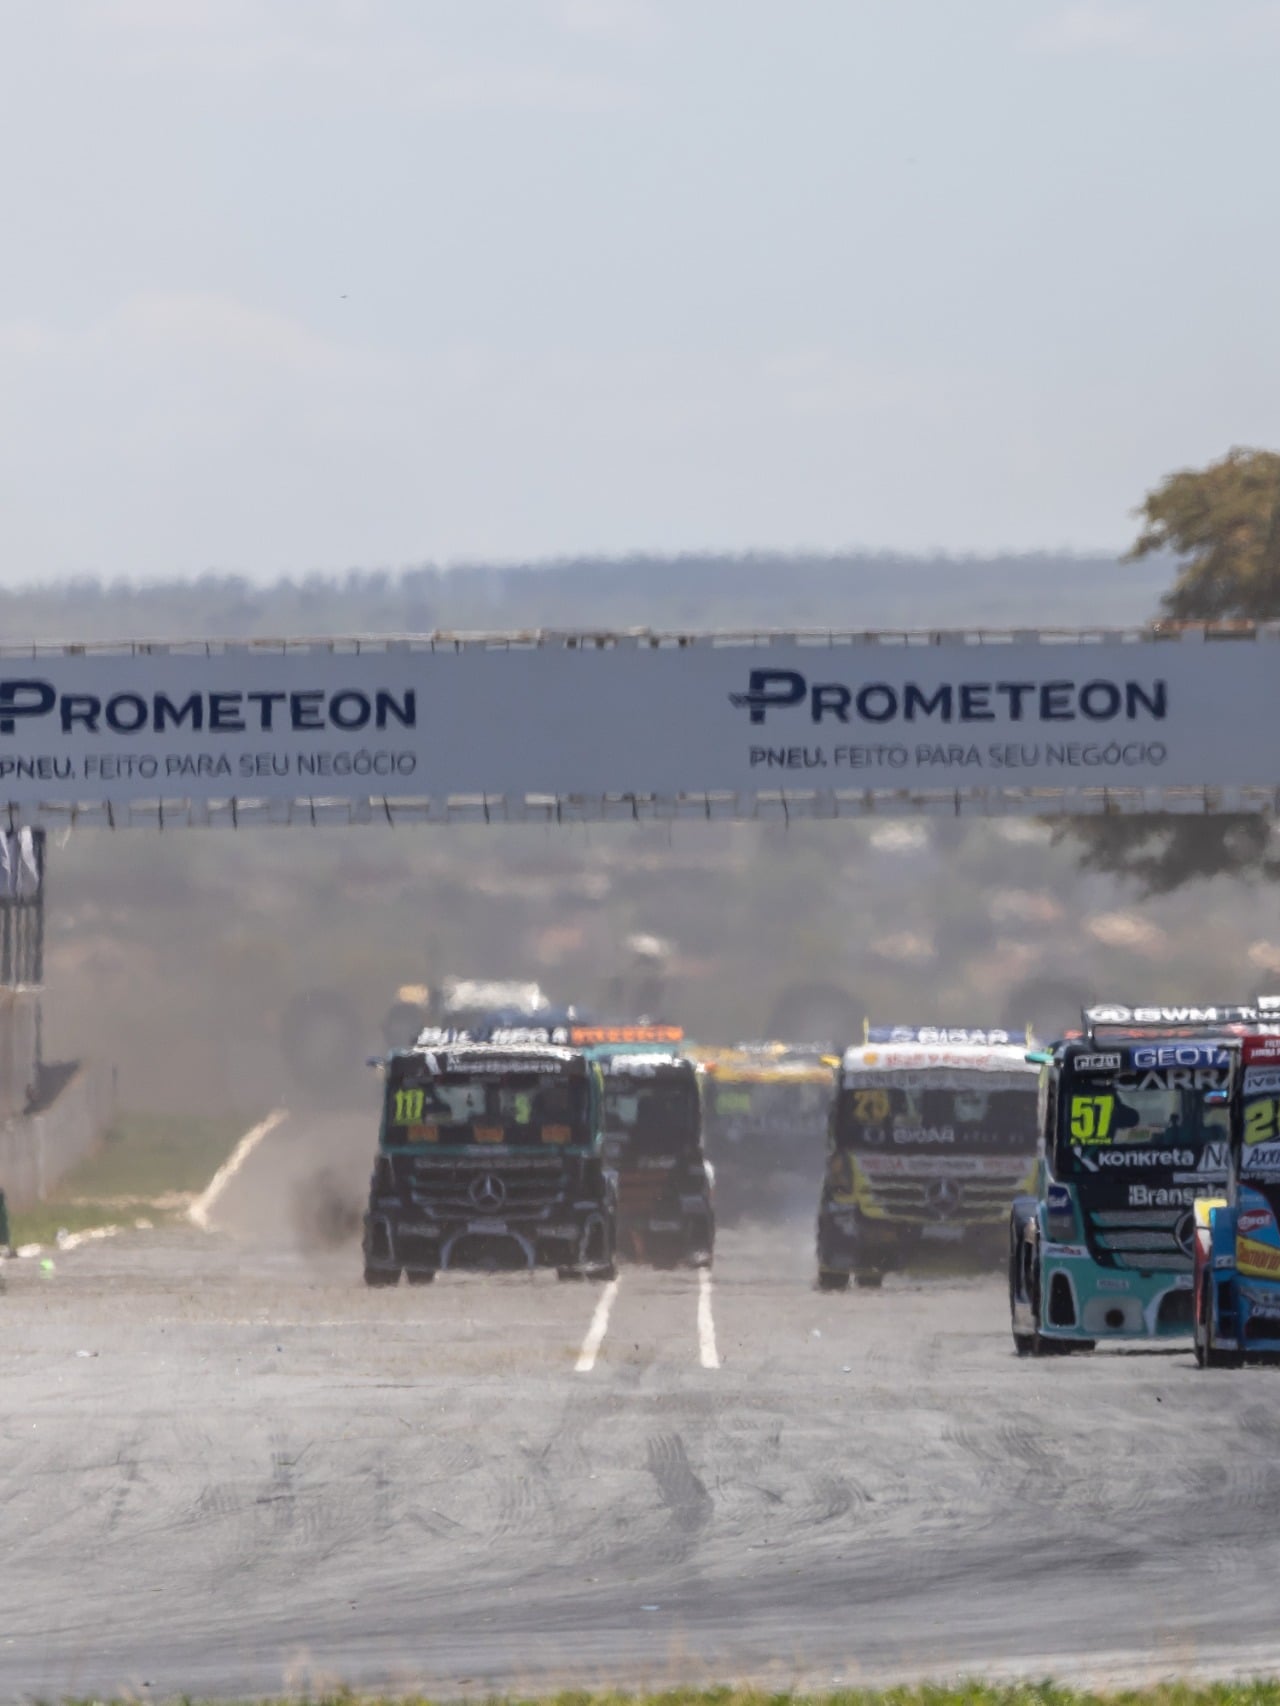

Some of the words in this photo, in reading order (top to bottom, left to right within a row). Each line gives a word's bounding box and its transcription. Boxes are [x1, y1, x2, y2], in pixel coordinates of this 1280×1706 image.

[0, 679, 418, 735] PROMETEON
[748, 668, 1168, 726] PROMETEON
[84, 754, 158, 779] FEITO
[166, 753, 232, 778] PARA
[239, 753, 290, 777] SEU
[297, 747, 417, 777] NEGÓCIO
[834, 743, 907, 768] FEITO
[915, 743, 982, 767] PARA
[989, 743, 1040, 767] SEU
[1046, 738, 1167, 766] NEGÓCIO
[1071, 1095, 1114, 1138] 57
[1098, 1147, 1195, 1168] konkreta
